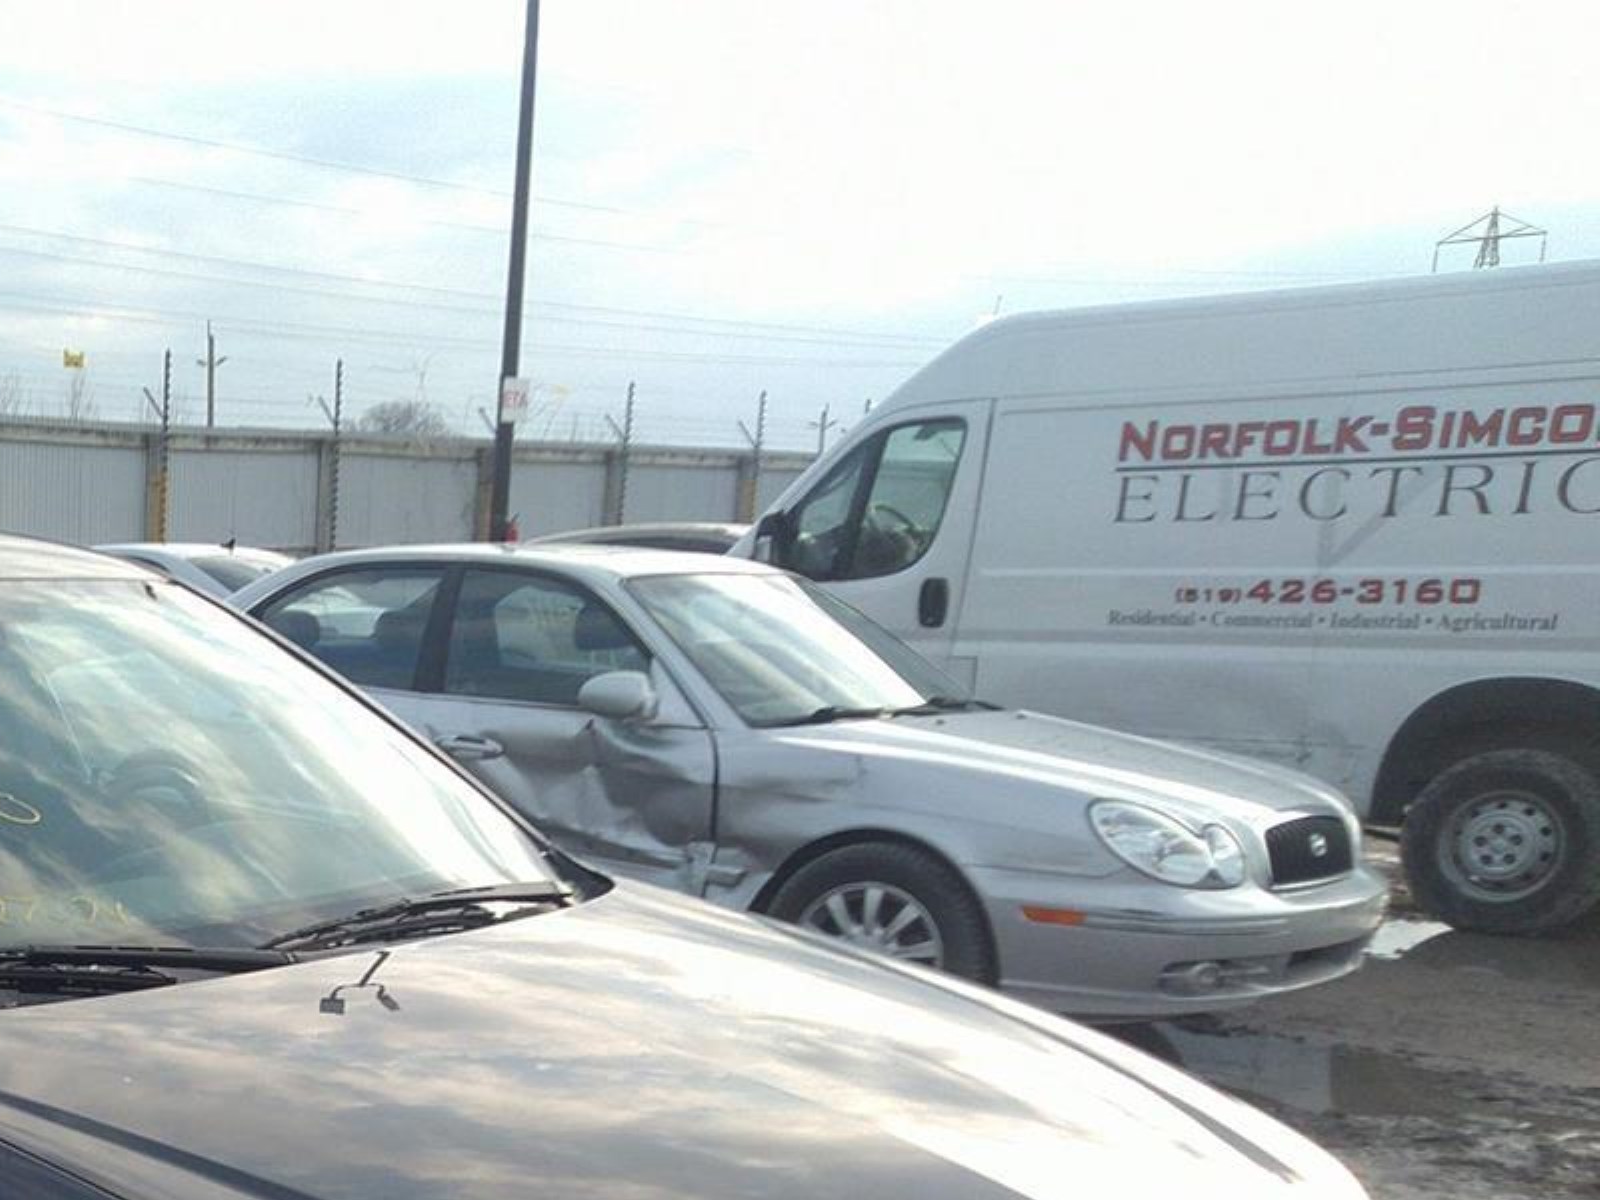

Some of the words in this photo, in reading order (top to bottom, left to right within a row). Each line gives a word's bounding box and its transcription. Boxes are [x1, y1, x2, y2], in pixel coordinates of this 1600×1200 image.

[1118, 404, 1600, 462] NORFOLK-SIMCO
[1113, 456, 1600, 523] ELECTRIC
[1108, 608, 1196, 627] Residential
[1211, 610, 1313, 628] Commercial
[1329, 611, 1422, 630] Industrial
[1437, 613, 1559, 633] Agricultural
